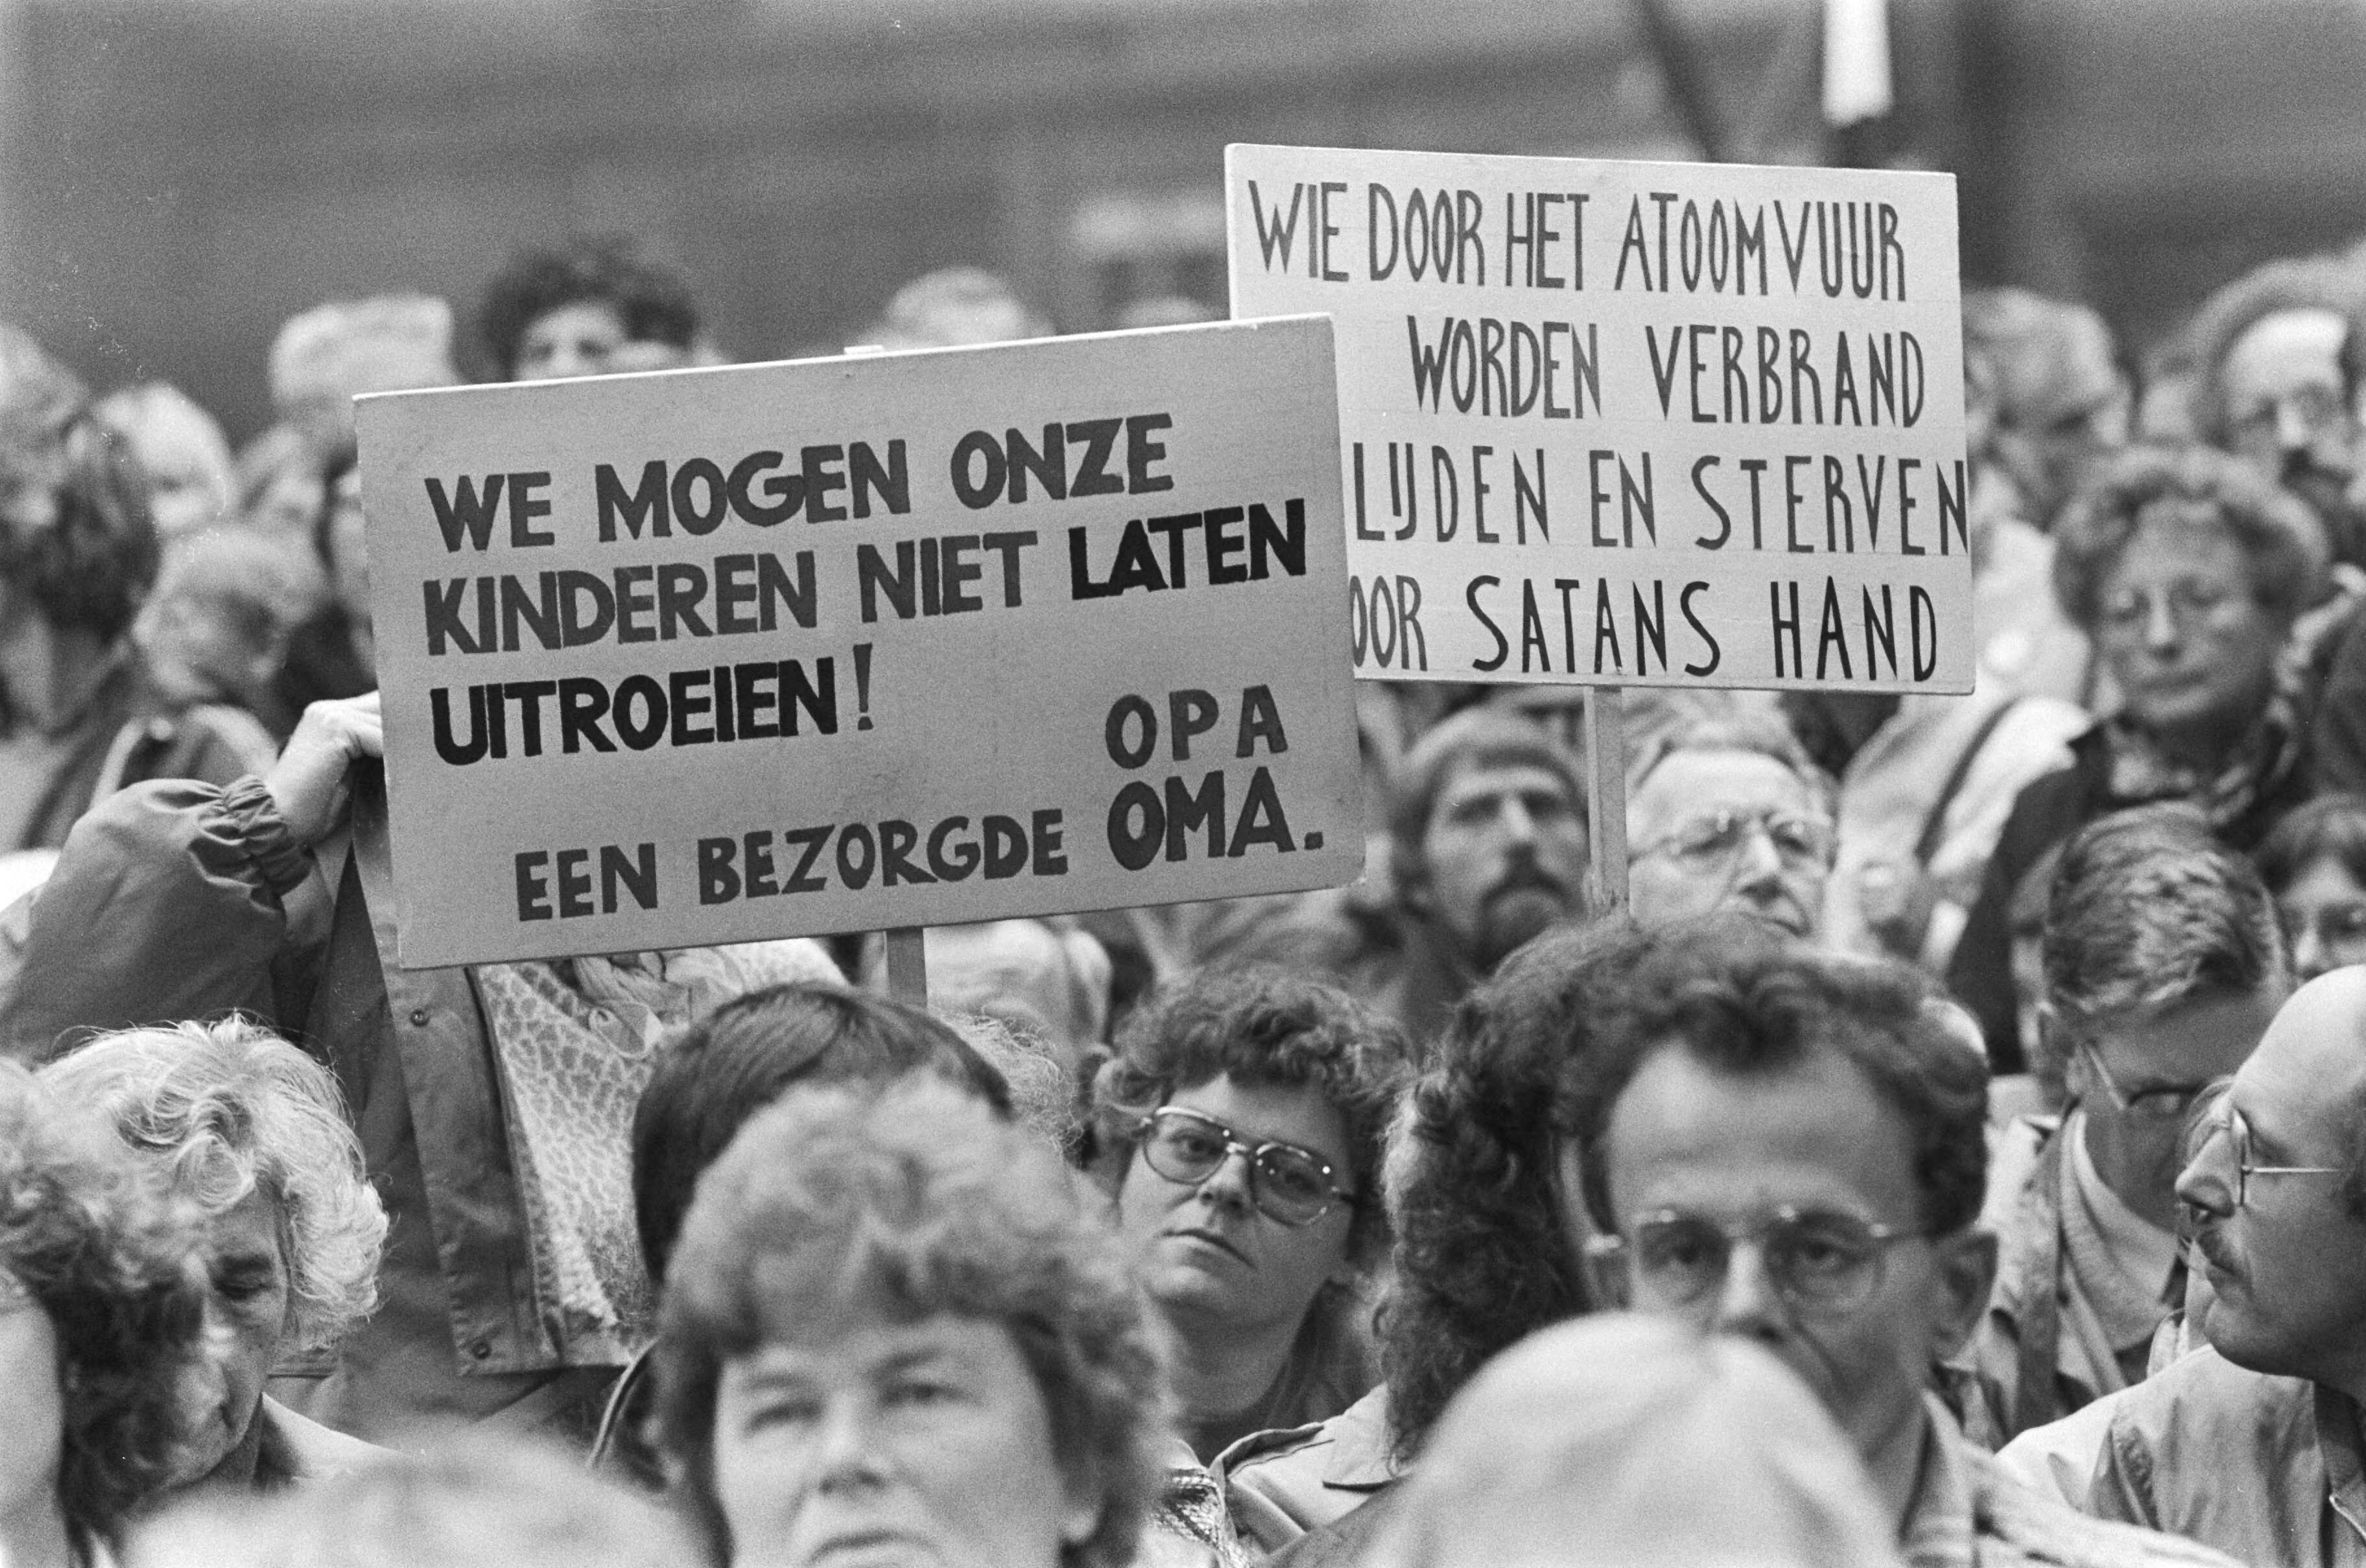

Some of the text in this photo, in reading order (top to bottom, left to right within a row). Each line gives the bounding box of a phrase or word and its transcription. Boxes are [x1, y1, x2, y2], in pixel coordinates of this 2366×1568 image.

[1248, 180, 1906, 302] WIE DOOR HET ATOOMVUUR
[1406, 315, 1925, 428] WORDEN VERBRAND
[424, 412, 1174, 554] WE MOGEN ONZE
[1353, 441, 1968, 557] LIJDEN EN STERVEN
[422, 497, 1308, 657] KINDEREN NIET LATEN
[1349, 574, 1938, 684] OOR SATANS HAND
[429, 642, 874, 767] UITROEIEN!
[1104, 684, 1289, 771] OPA
[514, 765, 1325, 923] EEN BEZORGDE OMA.
